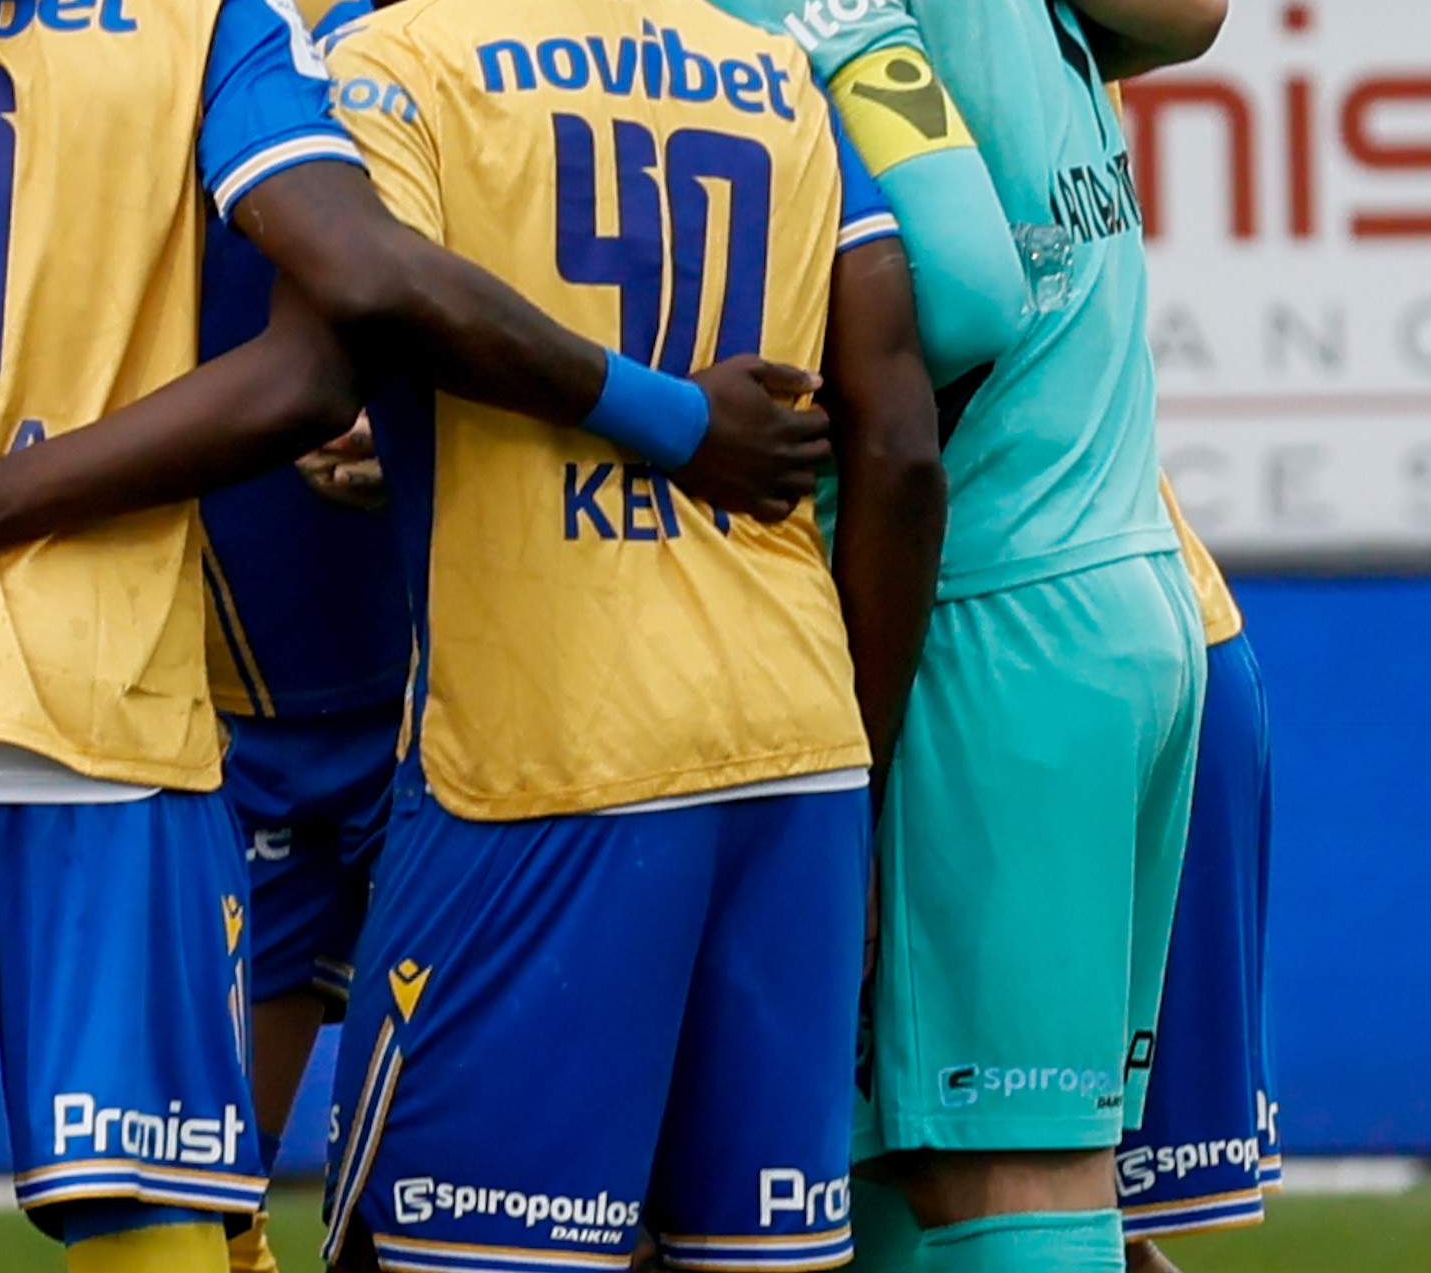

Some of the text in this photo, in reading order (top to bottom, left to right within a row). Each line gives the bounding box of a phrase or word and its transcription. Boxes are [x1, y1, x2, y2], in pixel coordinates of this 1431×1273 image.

[476, 18, 796, 122] novibet
[551, 111, 774, 386] 40
[435, 1180, 641, 1230] spiropoulos
[550, 1225, 624, 1246] DAIKIN
